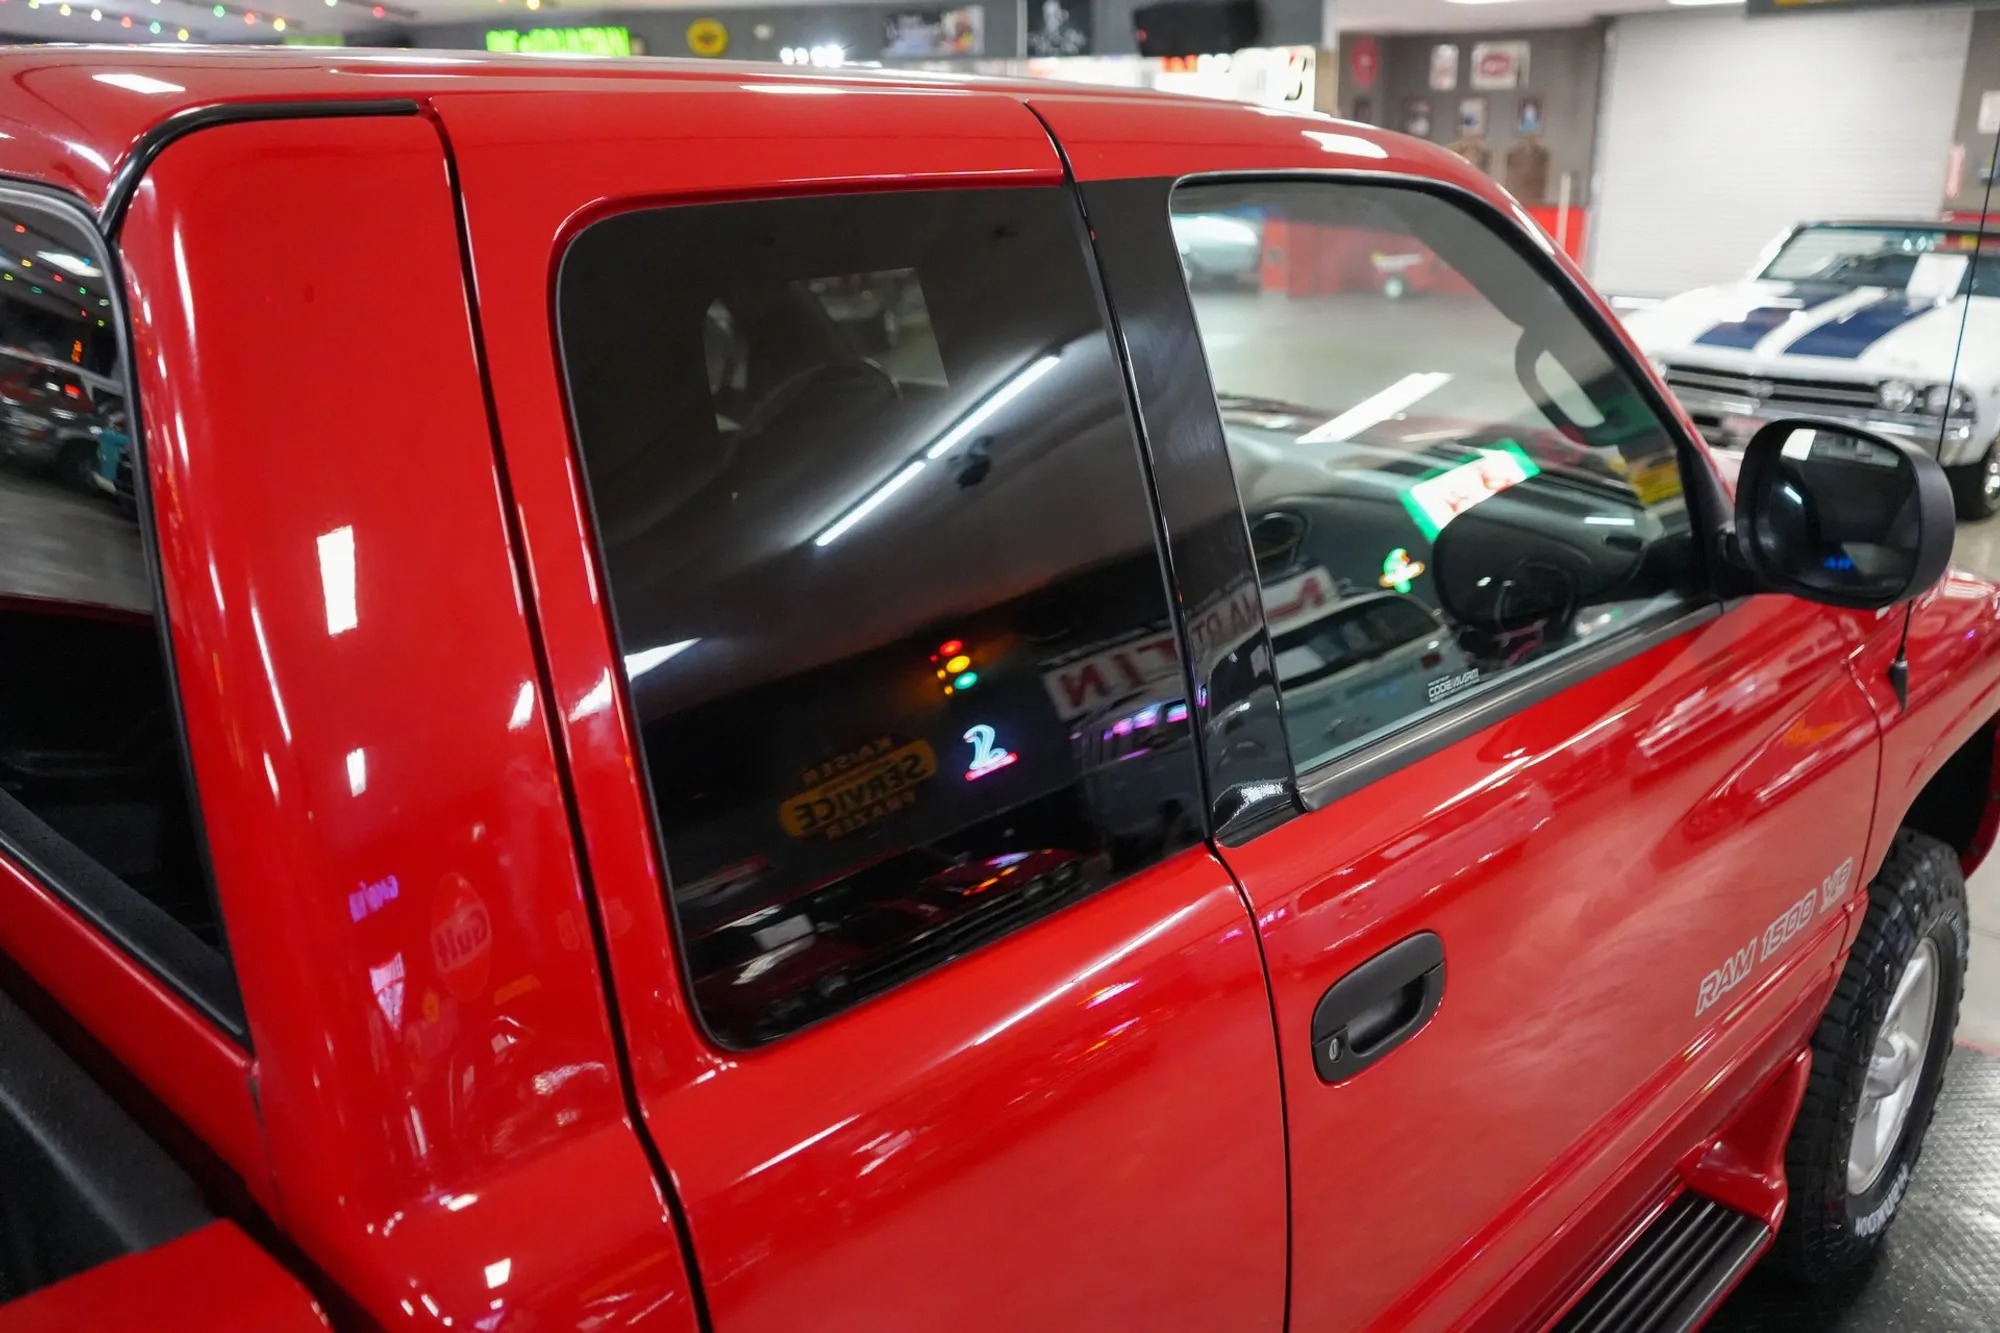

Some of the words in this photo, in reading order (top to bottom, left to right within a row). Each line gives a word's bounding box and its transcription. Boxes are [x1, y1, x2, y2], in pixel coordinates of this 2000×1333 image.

[1428, 680, 1453, 698] CODE
[1695, 937, 1758, 1017] RAM
[1760, 888, 1818, 963] 1500
[1821, 857, 1853, 909] V8
